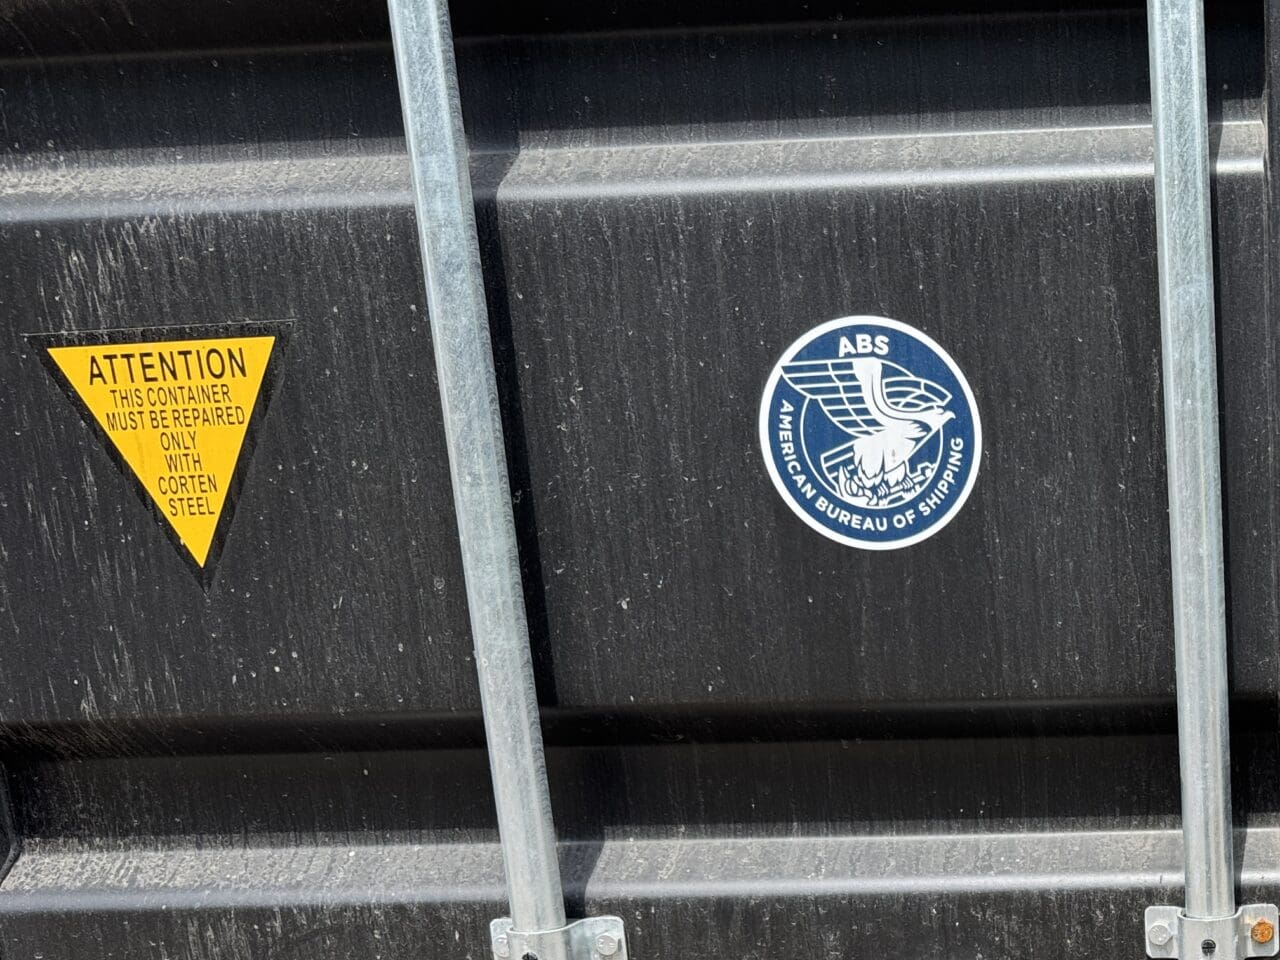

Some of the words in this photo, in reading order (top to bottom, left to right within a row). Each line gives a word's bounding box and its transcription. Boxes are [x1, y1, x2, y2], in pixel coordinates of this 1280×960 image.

[838, 333, 890, 357] ABS
[89, 347, 248, 386] ATTENTION
[110, 388, 144, 409] THIS
[147, 384, 232, 407] CONTAINER
[106, 410, 146, 431] MUST
[150, 410, 169, 429] BE
[172, 405, 246, 428] REPAIRED
[160, 431, 197, 451] ONLY
[164, 453, 203, 473] WITH
[778, 399, 817, 500] AMERICAN
[815, 496, 888, 532] BUREAU
[892, 509, 916, 528] OF
[918, 437, 964, 517] SHIPPING
[158, 474, 218, 494] CORTEN
[168, 497, 215, 517] STEEL
